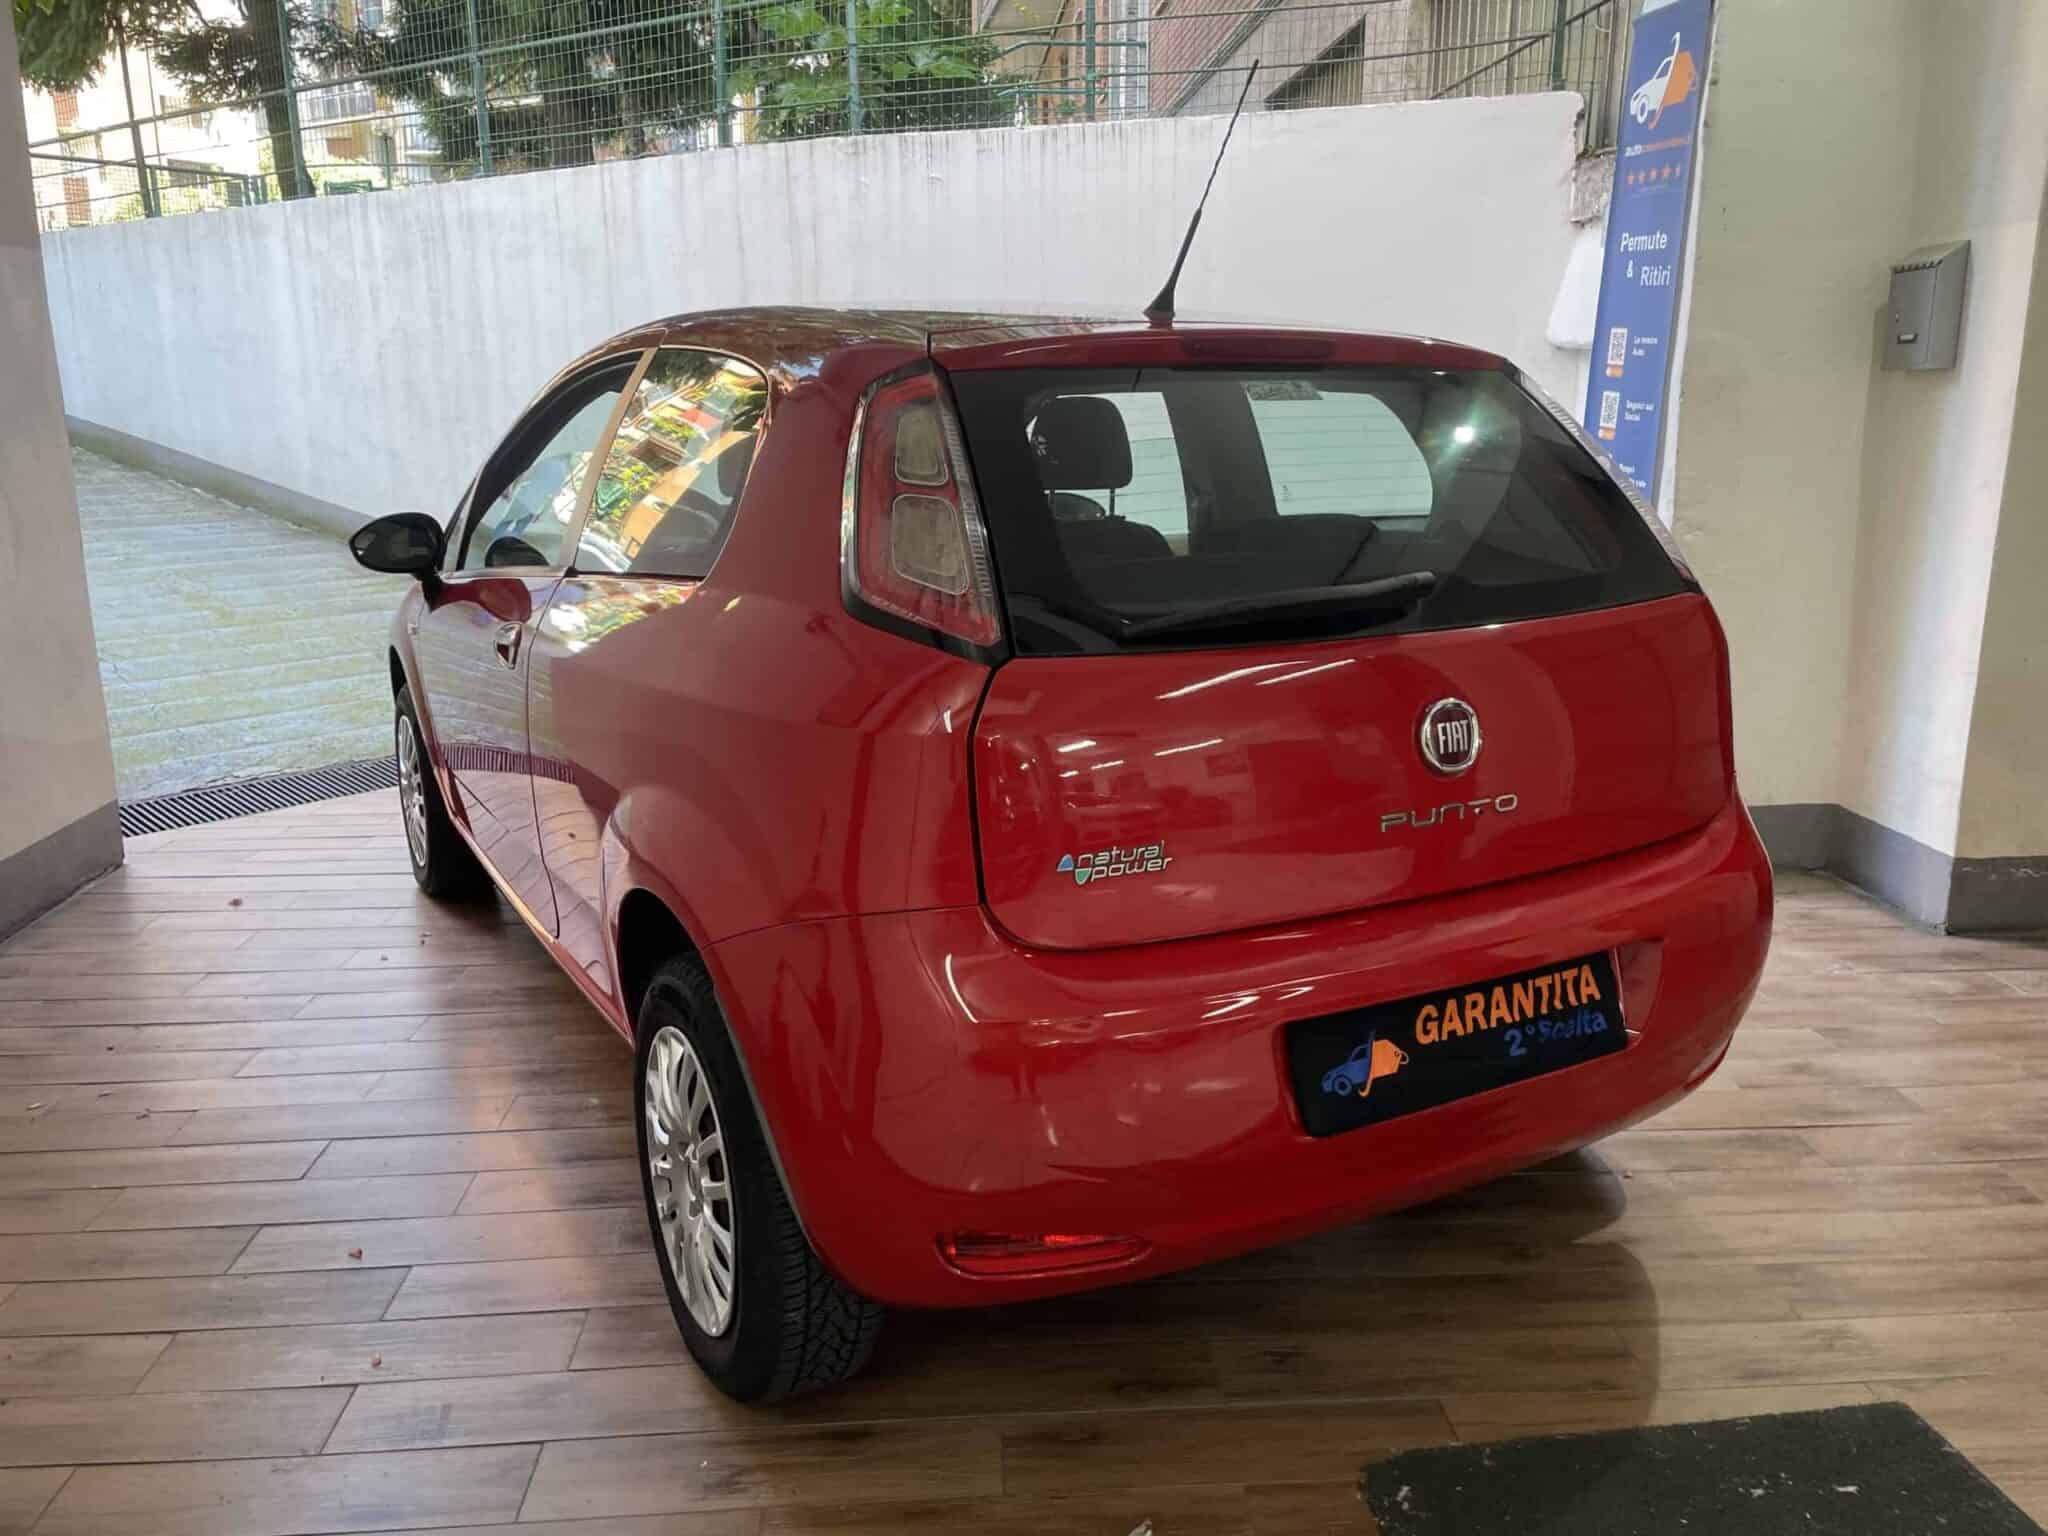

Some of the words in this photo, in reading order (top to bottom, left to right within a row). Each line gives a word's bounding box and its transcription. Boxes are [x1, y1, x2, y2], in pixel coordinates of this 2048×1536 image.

[1620, 230, 1668, 252] Permute
[1640, 265, 1671, 287] Ritiri
[1436, 719, 1469, 754] FIAT
[1381, 793, 1518, 833] PUNTO
[1077, 839, 1165, 867] natural
[1090, 857, 1173, 882] power
[1415, 963, 1601, 1046] GARANTITA
[1538, 1007, 1608, 1043] Scelta
